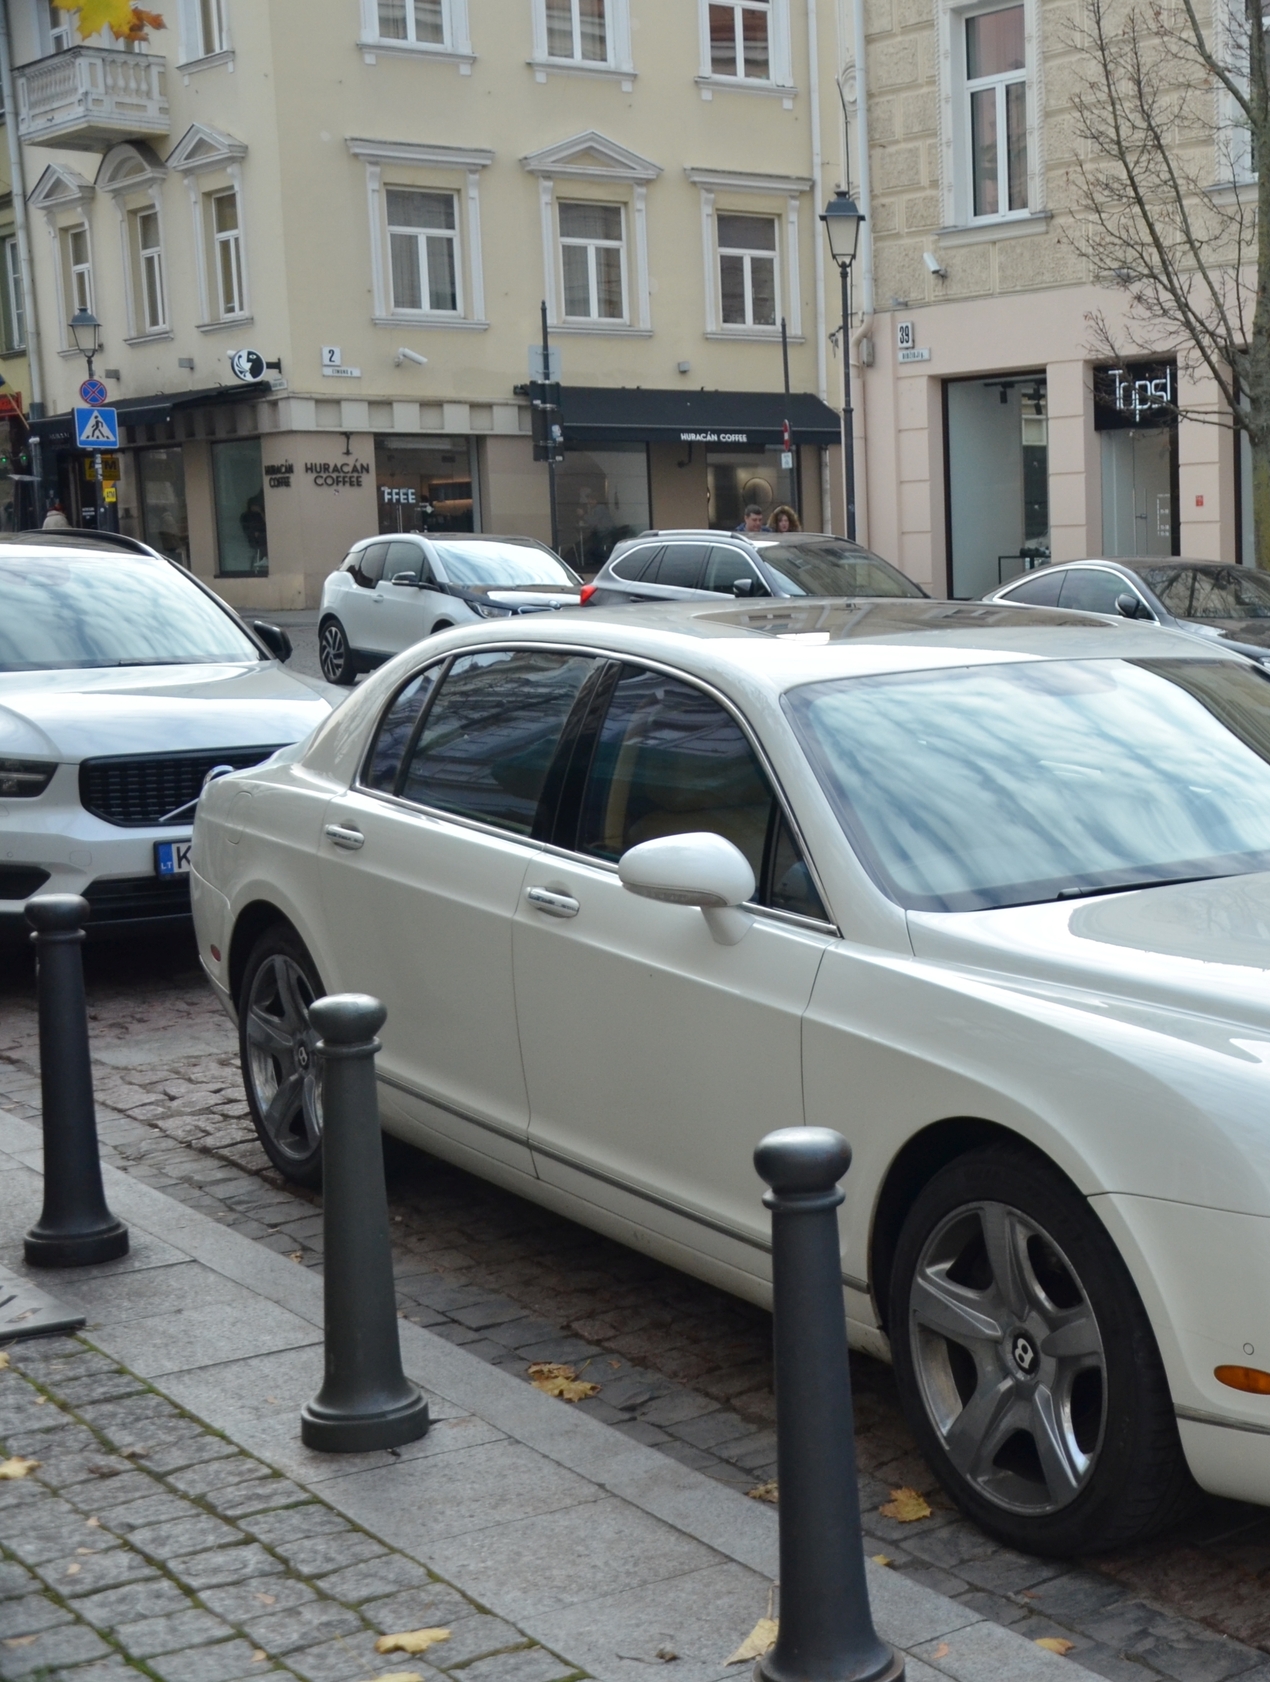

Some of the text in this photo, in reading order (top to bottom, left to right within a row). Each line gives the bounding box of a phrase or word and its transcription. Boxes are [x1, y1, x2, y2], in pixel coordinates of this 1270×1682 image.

[899, 325, 910, 344] 39
[328, 349, 336, 363] 2
[720, 434, 748, 442] COFFEE
[88, 460, 117, 471] AM
[305, 459, 370, 474] HURACÁN
[314, 475, 362, 487] COFFEE
[160, 862, 173, 870] LT
